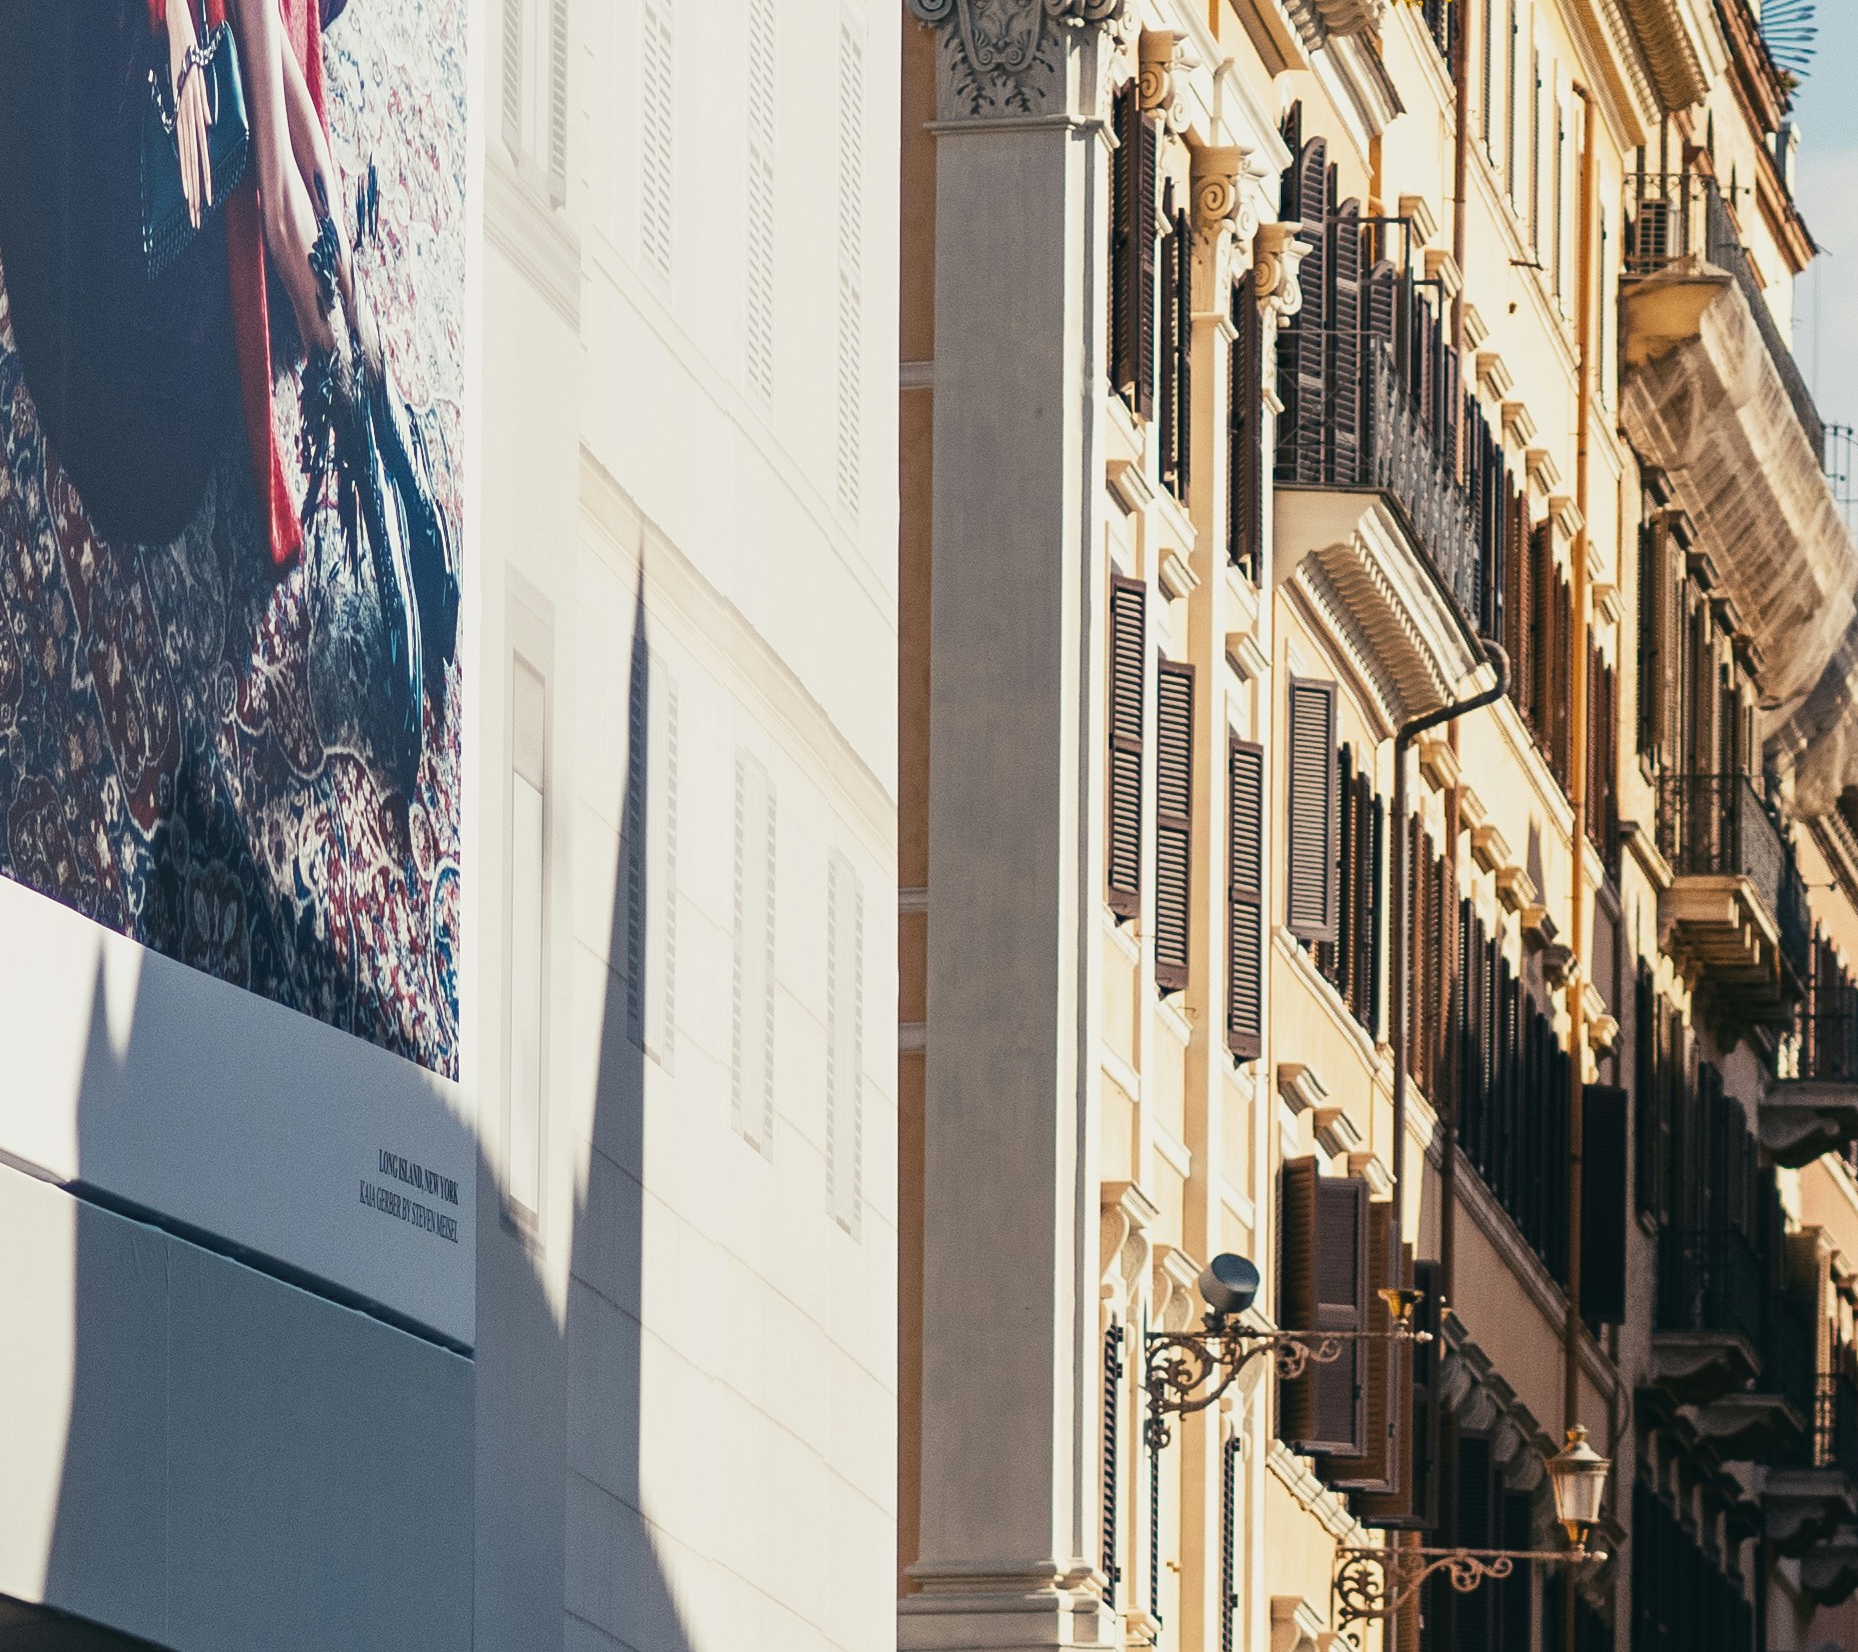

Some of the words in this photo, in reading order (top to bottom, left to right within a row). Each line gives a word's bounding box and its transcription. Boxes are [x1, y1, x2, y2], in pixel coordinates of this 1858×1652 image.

[378, 1149, 398, 1178] LONG
[425, 1168, 439, 1196] NEW
[438, 1175, 459, 1205] YORK
[359, 1180, 376, 1208] KAIA
[376, 1186, 401, 1218] GERBER
[401, 1197, 411, 1222] BY
[411, 1202, 436, 1233] STEVEN
[435, 1212, 459, 1243] MEISEL
